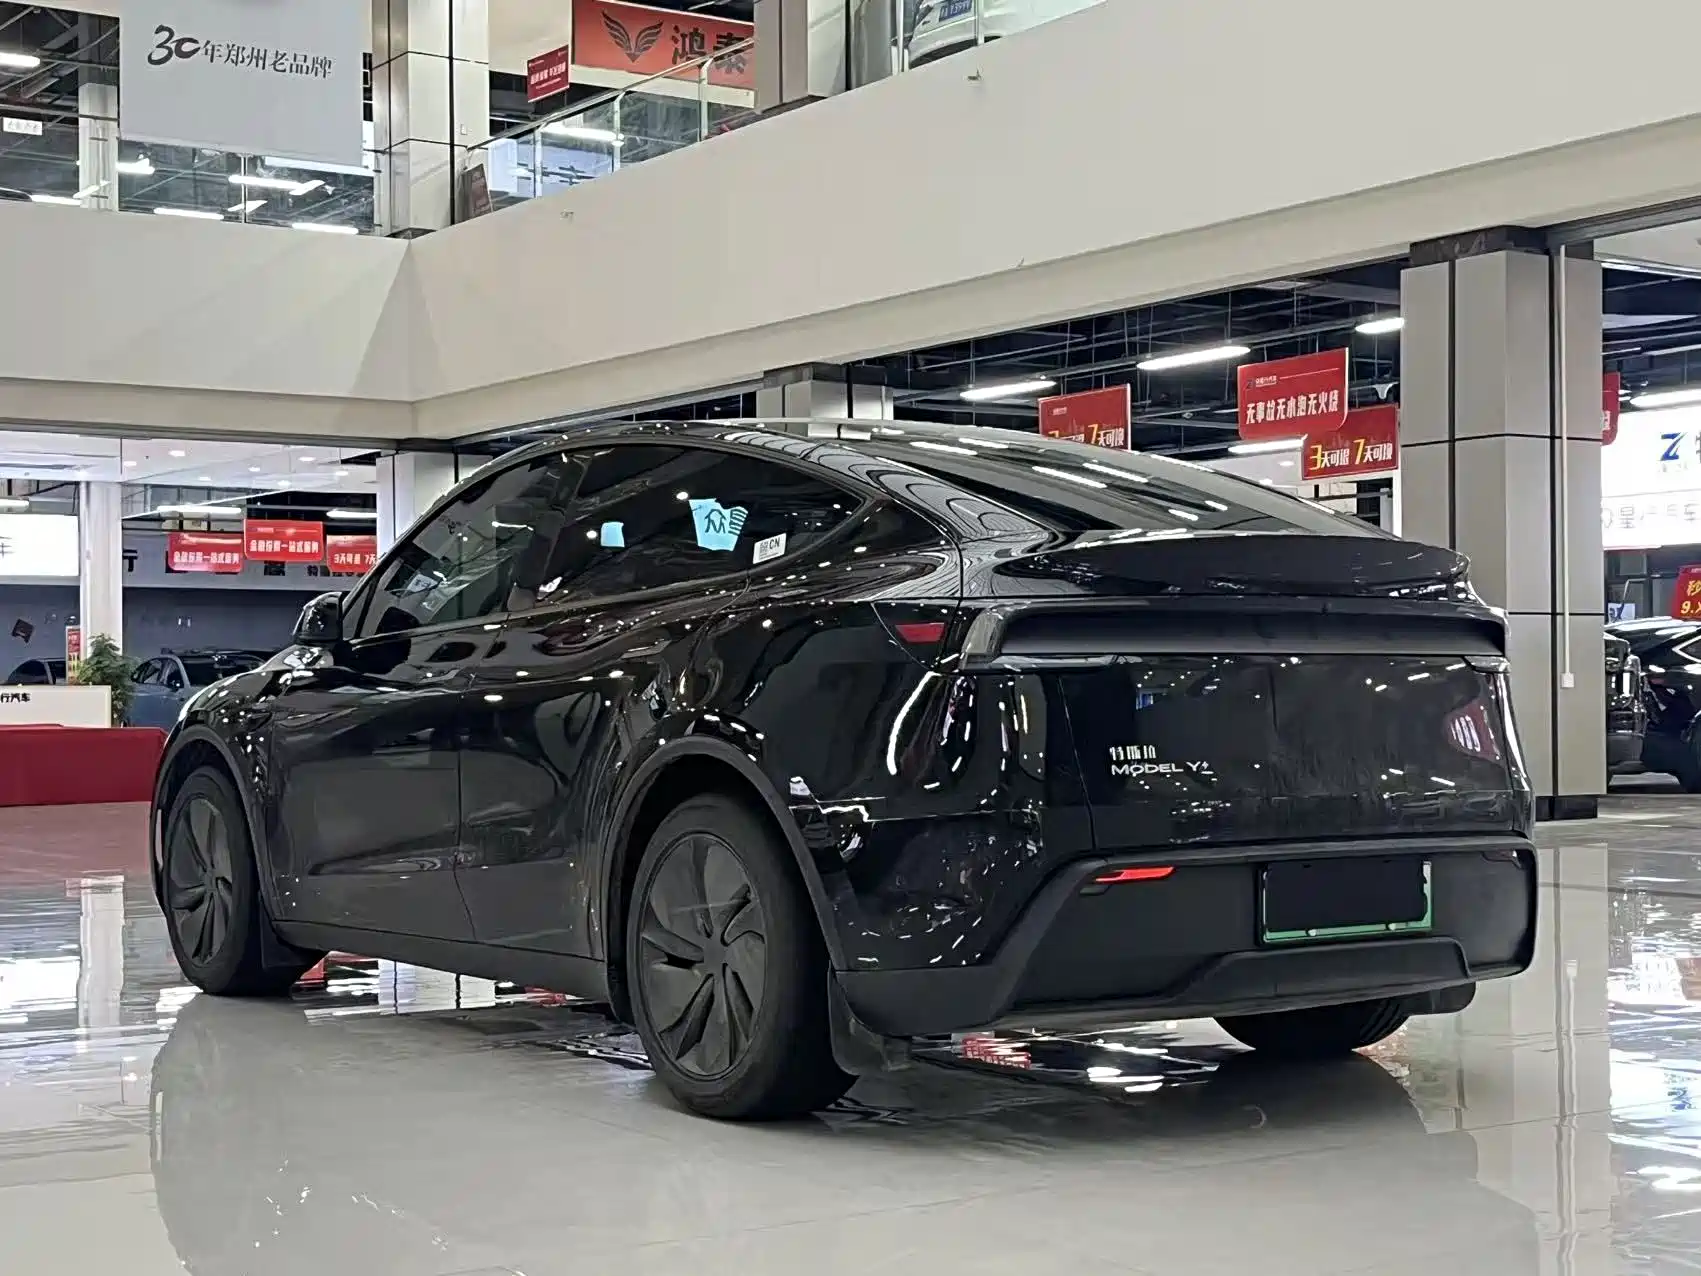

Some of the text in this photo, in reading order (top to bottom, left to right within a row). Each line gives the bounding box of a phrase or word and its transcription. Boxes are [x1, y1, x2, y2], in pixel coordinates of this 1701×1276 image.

[147, 24, 332, 79] 30年郑州老品牌
[1111, 763, 1184, 776] MODEL
